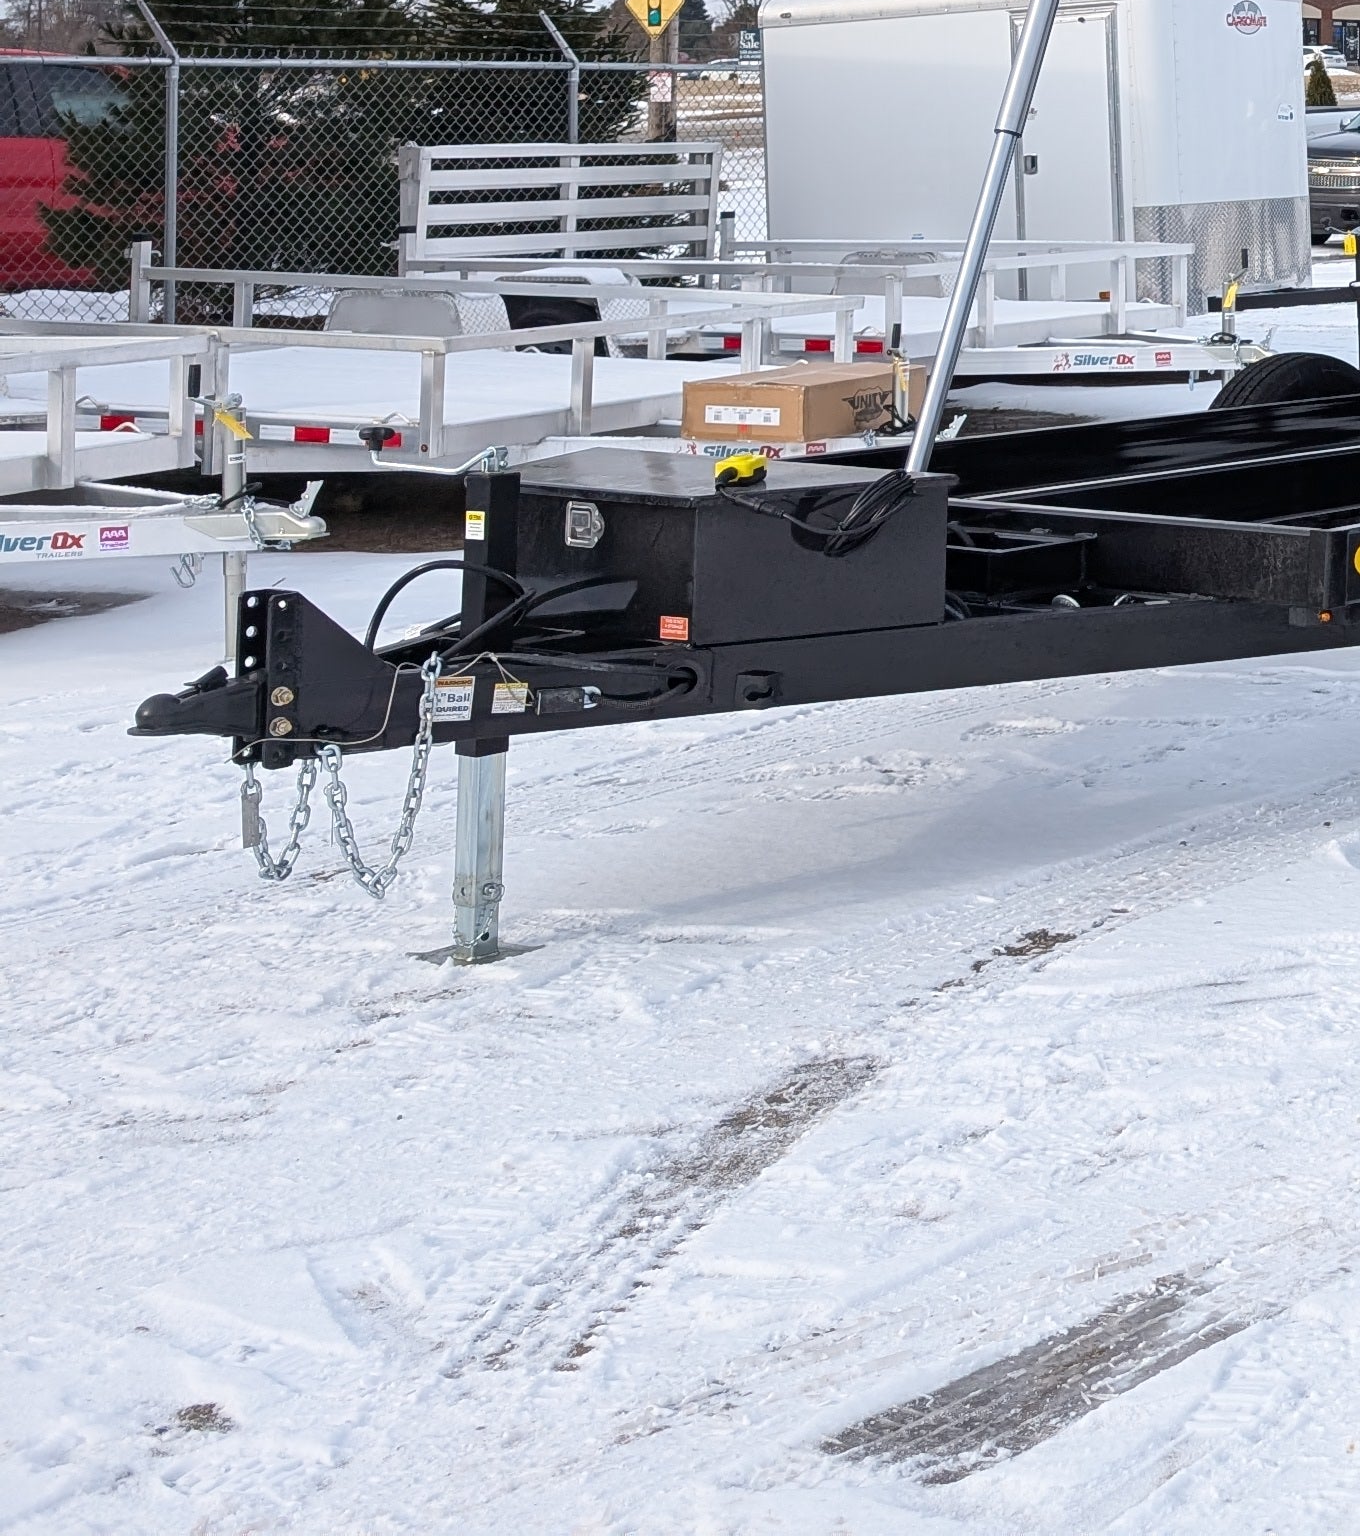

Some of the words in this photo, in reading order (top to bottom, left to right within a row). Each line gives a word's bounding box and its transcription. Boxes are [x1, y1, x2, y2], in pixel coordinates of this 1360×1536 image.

[740, 30, 755, 41] For
[740, 40, 760, 49] Sale
[1073, 354, 1136, 366] SilverOx
[101, 529, 127, 539] AAA
[36, 551, 83, 559] TRAILERS
